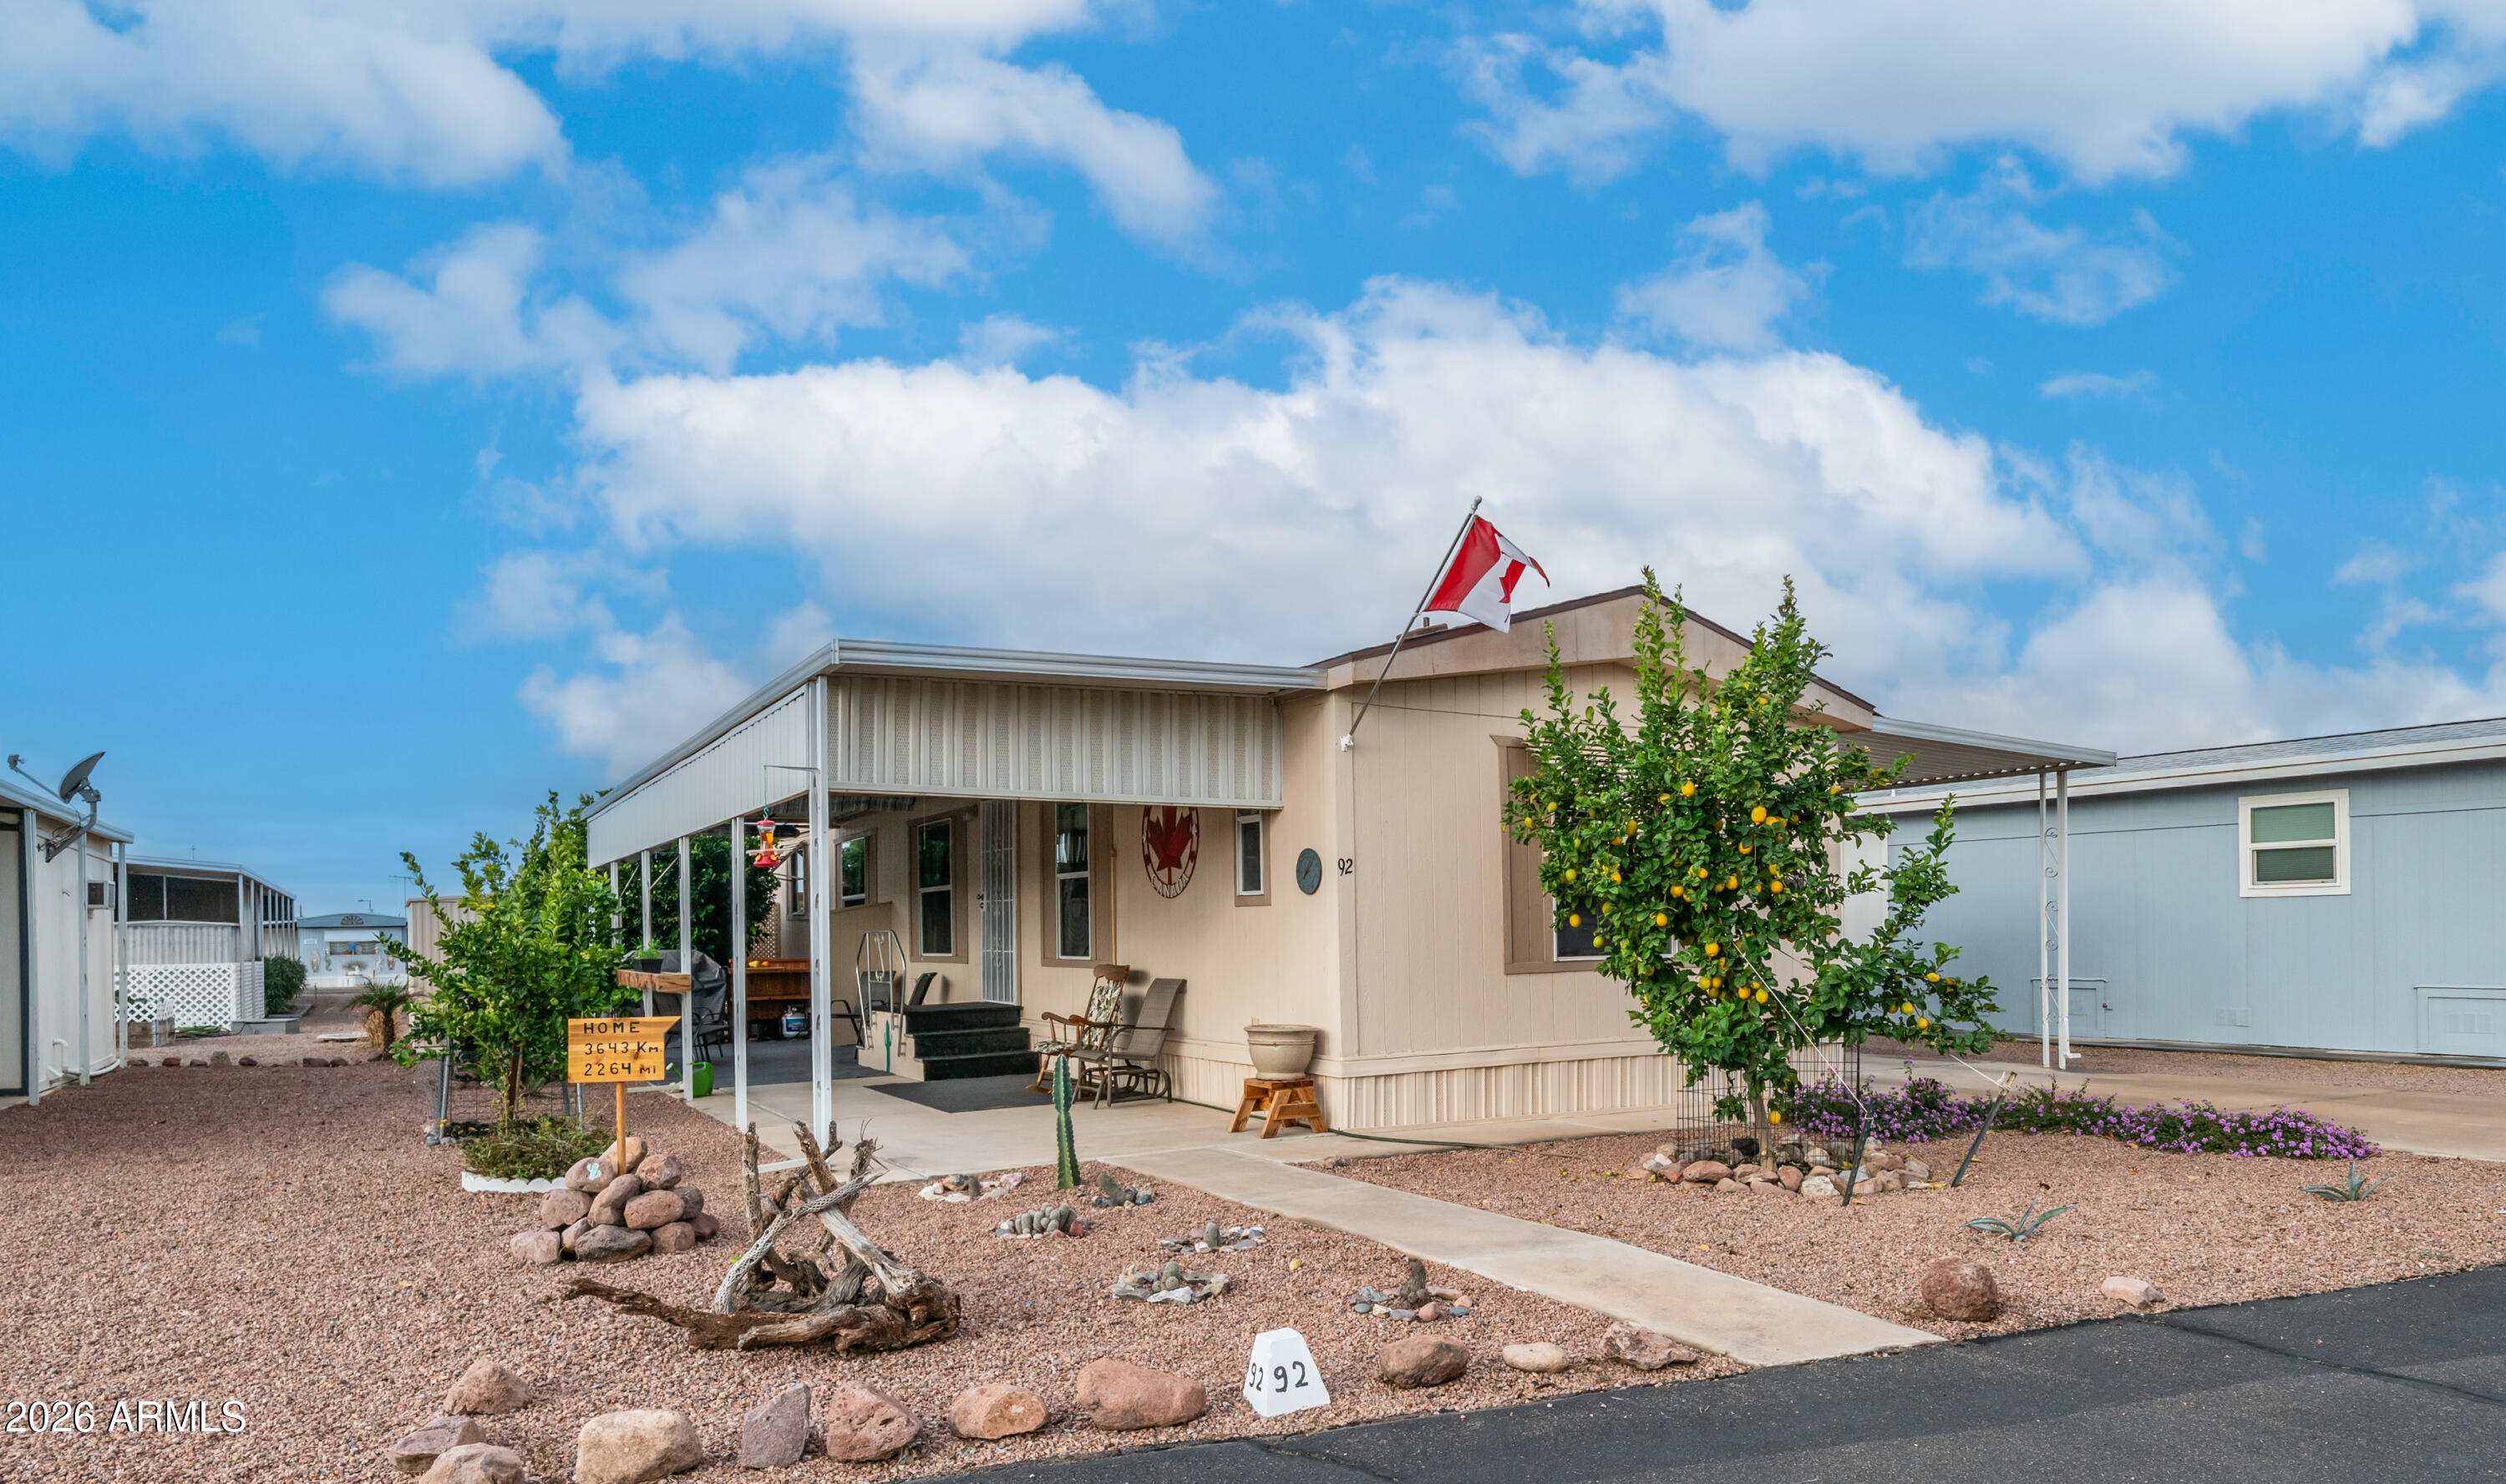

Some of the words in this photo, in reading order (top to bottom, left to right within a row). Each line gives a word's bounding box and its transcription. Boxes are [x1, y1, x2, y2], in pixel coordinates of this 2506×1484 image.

[1337, 858, 1353, 877] 92
[1150, 874, 1190, 899] CANADA
[584, 1021, 640, 1034] HOME
[585, 1041, 629, 1055] 3643
[584, 1062, 632, 1076] 2264
[1249, 1362, 1264, 1391] 92
[1274, 1360, 1309, 1393] 92
